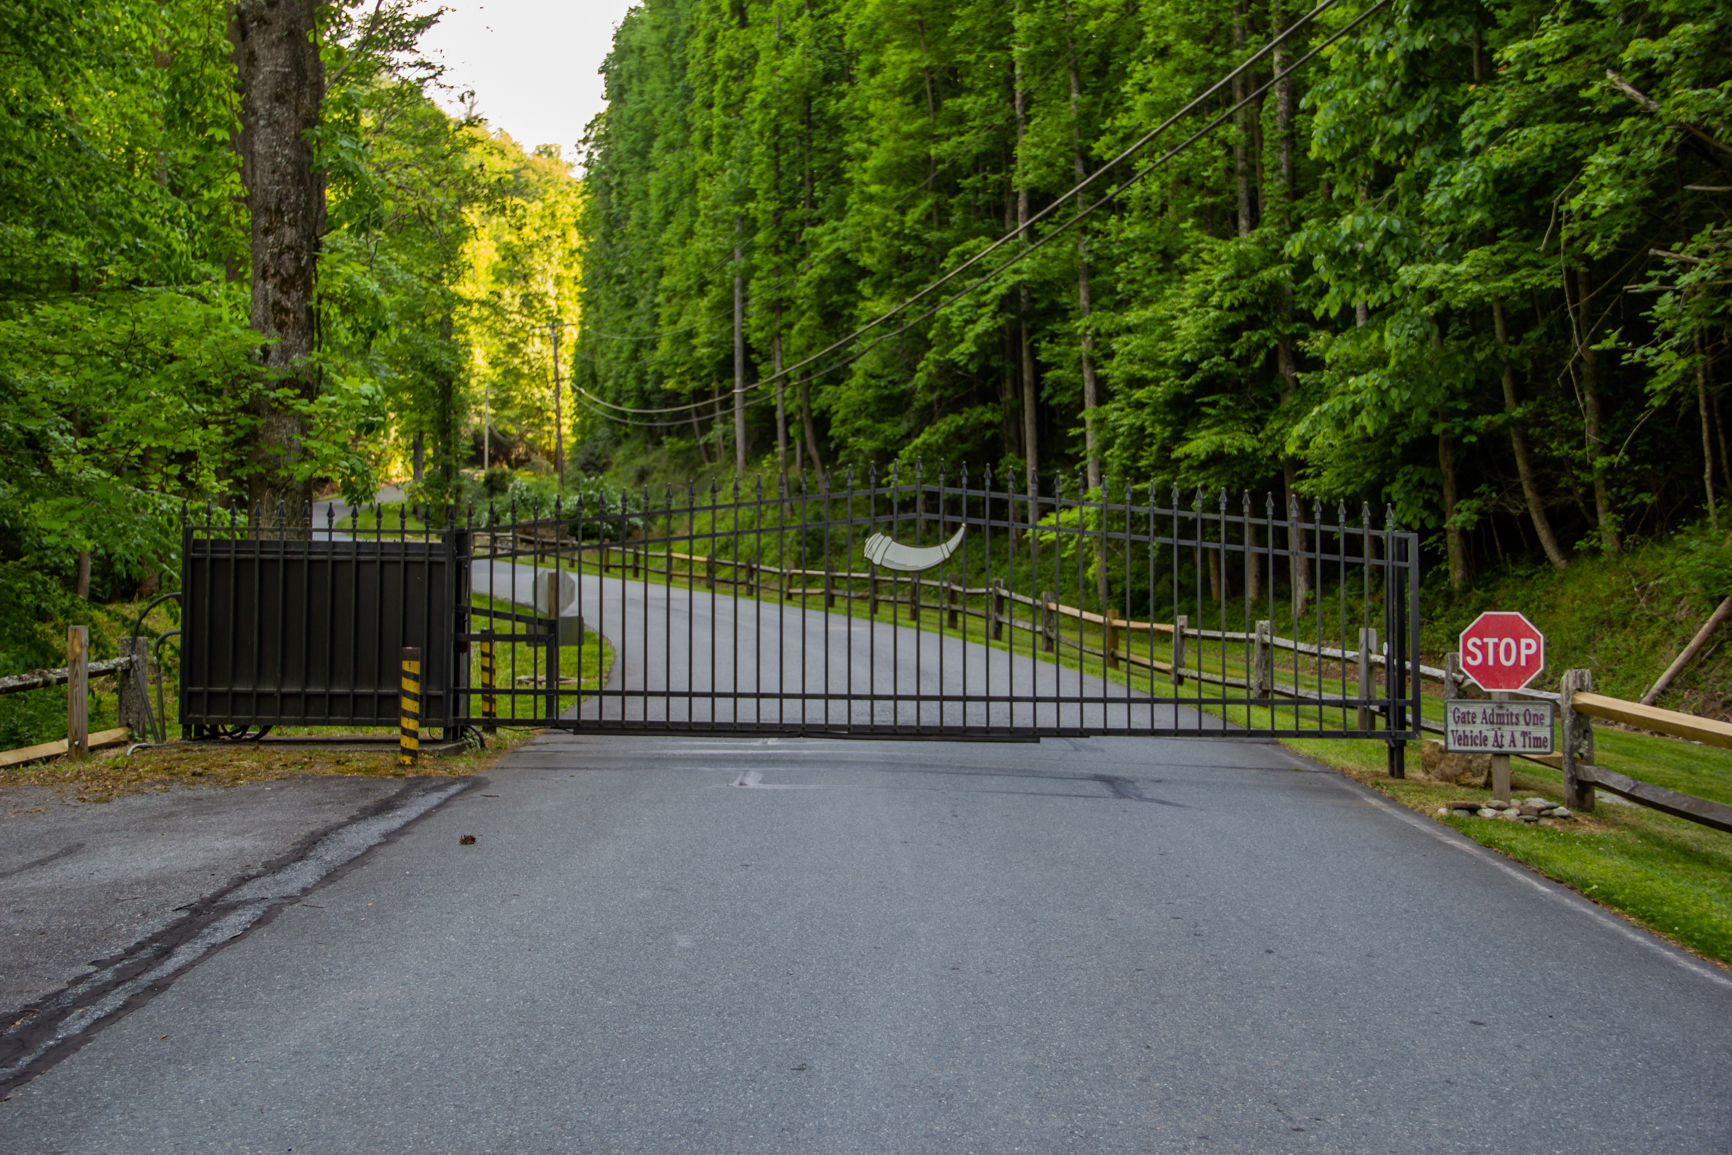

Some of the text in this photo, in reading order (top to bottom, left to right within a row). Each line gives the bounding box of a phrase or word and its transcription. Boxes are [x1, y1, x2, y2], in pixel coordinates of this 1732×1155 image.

[1466, 637, 1537, 666] STOP
[1452, 707, 1545, 726] Gate Admits One
[1451, 730, 1548, 748] Vehicle At A Time
